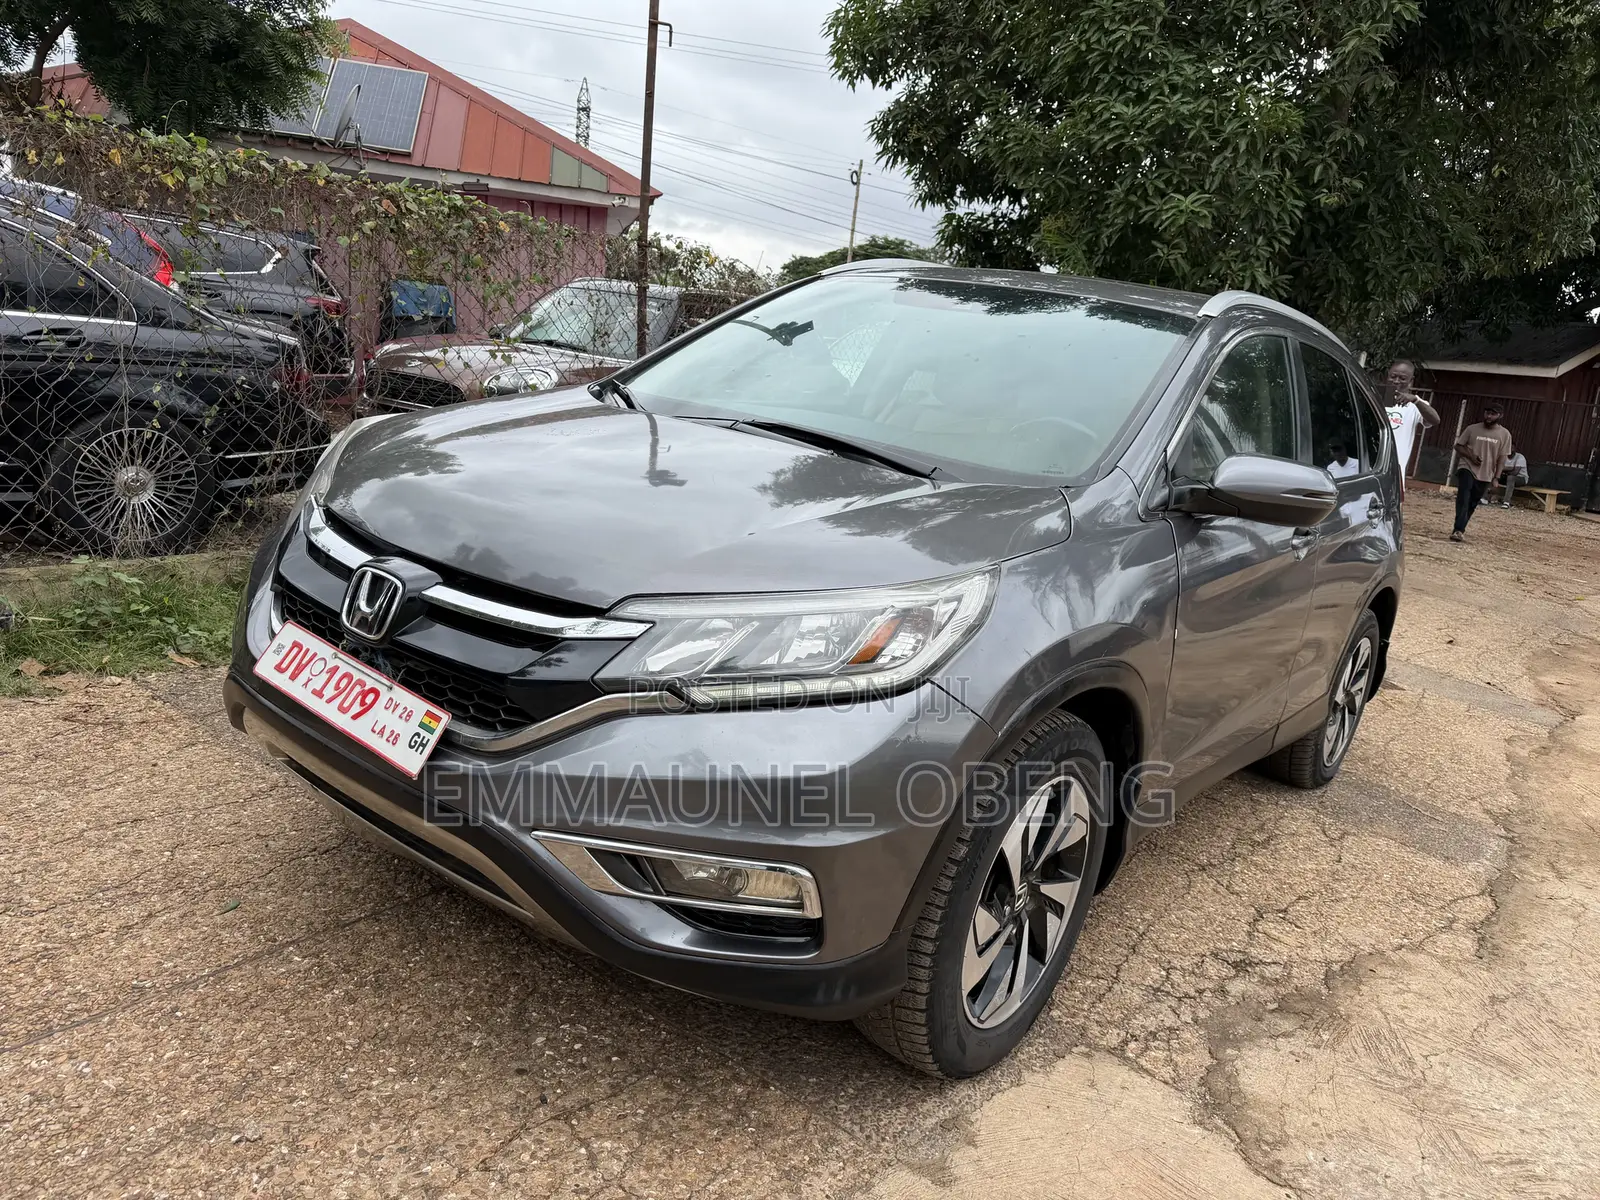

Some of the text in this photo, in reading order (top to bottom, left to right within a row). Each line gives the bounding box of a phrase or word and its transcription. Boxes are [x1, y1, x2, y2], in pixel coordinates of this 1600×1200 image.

[274, 640, 381, 721] DV 1909
[383, 696, 401, 714] DV
[371, 719, 387, 739] LA
[408, 731, 430, 756] GH
